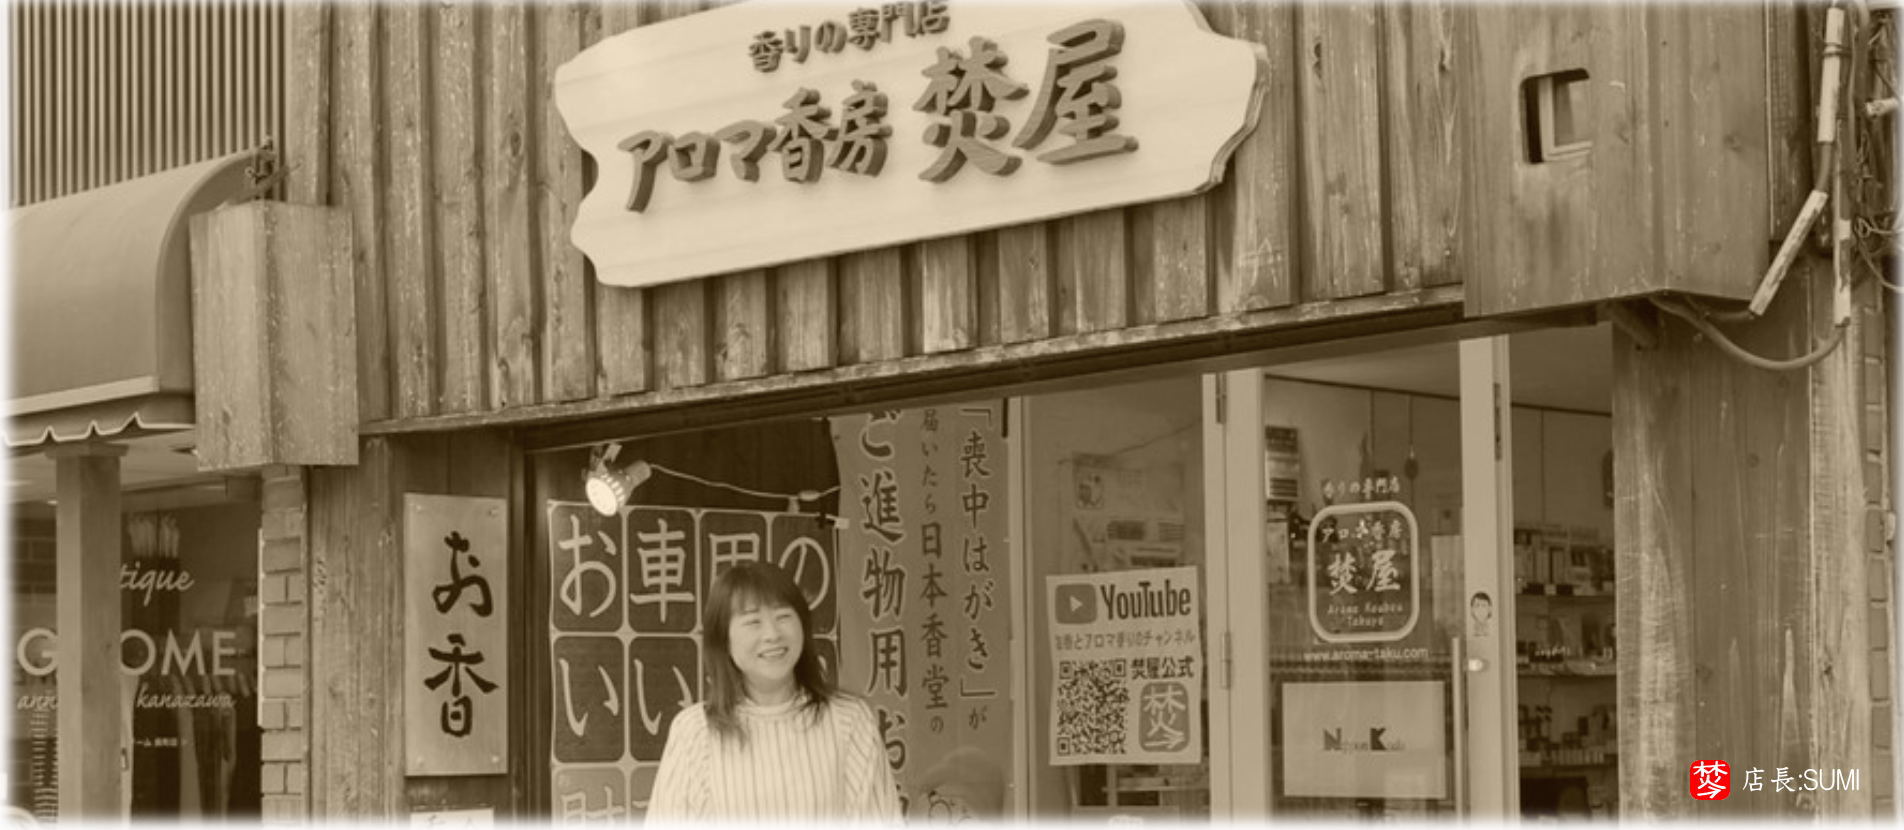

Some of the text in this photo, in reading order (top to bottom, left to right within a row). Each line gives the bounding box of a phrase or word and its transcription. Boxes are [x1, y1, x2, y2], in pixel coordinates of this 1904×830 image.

[617, 18, 1139, 213] アロマ香房 焚屋
[120, 561, 196, 607] tique
[959, 408, 996, 731] 「喪中はがき」が
[1327, 549, 1400, 595] 焚屋
[861, 408, 910, 818] ご進物用お
[1100, 579, 1192, 620] YouTube
[17, 627, 236, 676] GOME
[423, 530, 499, 738] お香
[1303, 646, 1429, 662] www.aroma-taku.com
[1131, 655, 1195, 680] 焚屋公式
